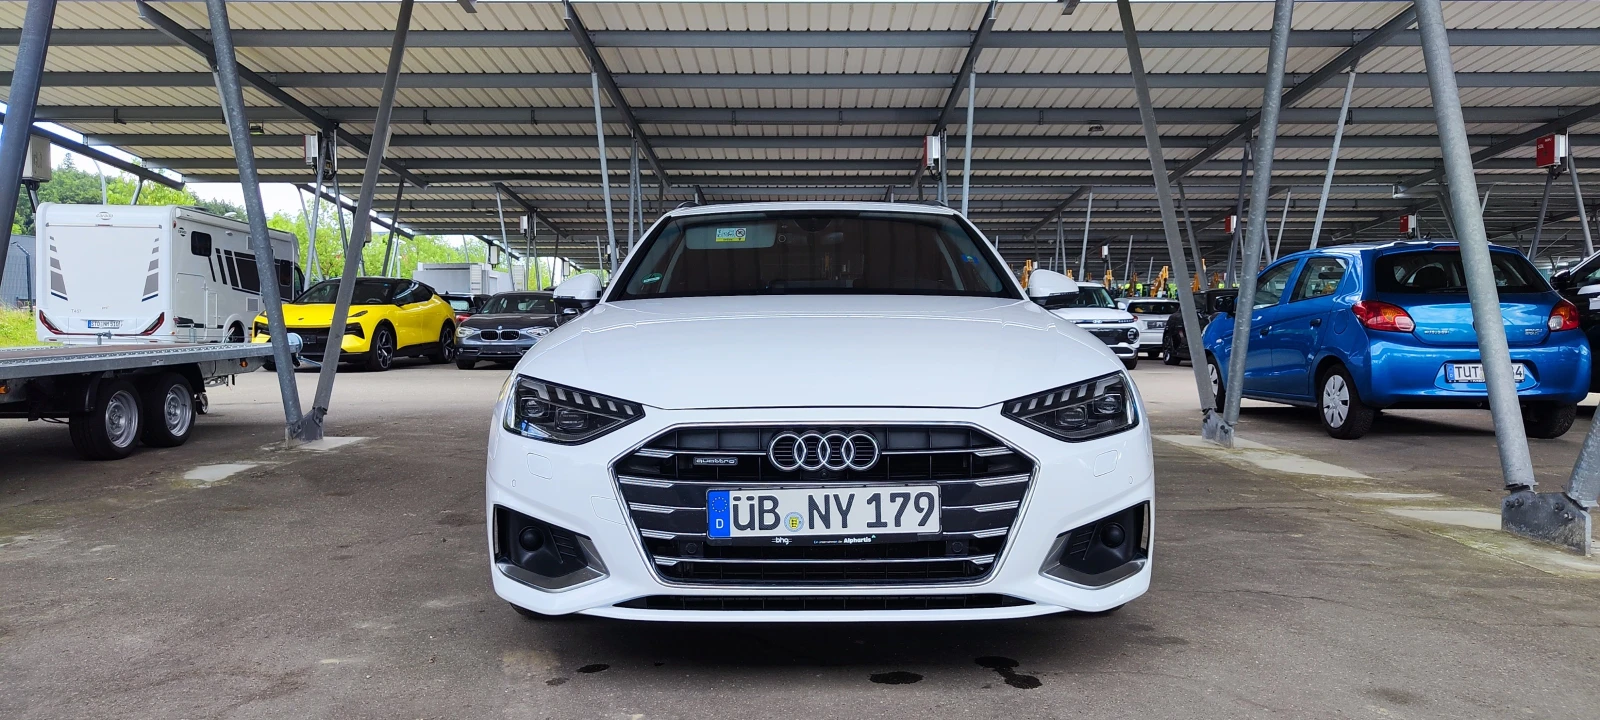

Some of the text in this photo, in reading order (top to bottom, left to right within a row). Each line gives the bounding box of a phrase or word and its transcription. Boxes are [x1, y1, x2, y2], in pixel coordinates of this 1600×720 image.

[1455, 366, 1479, 378] TUT
[715, 518, 724, 529] D
[808, 493, 856, 530] NY
[866, 491, 935, 529] 179
[775, 537, 789, 546] bhg
